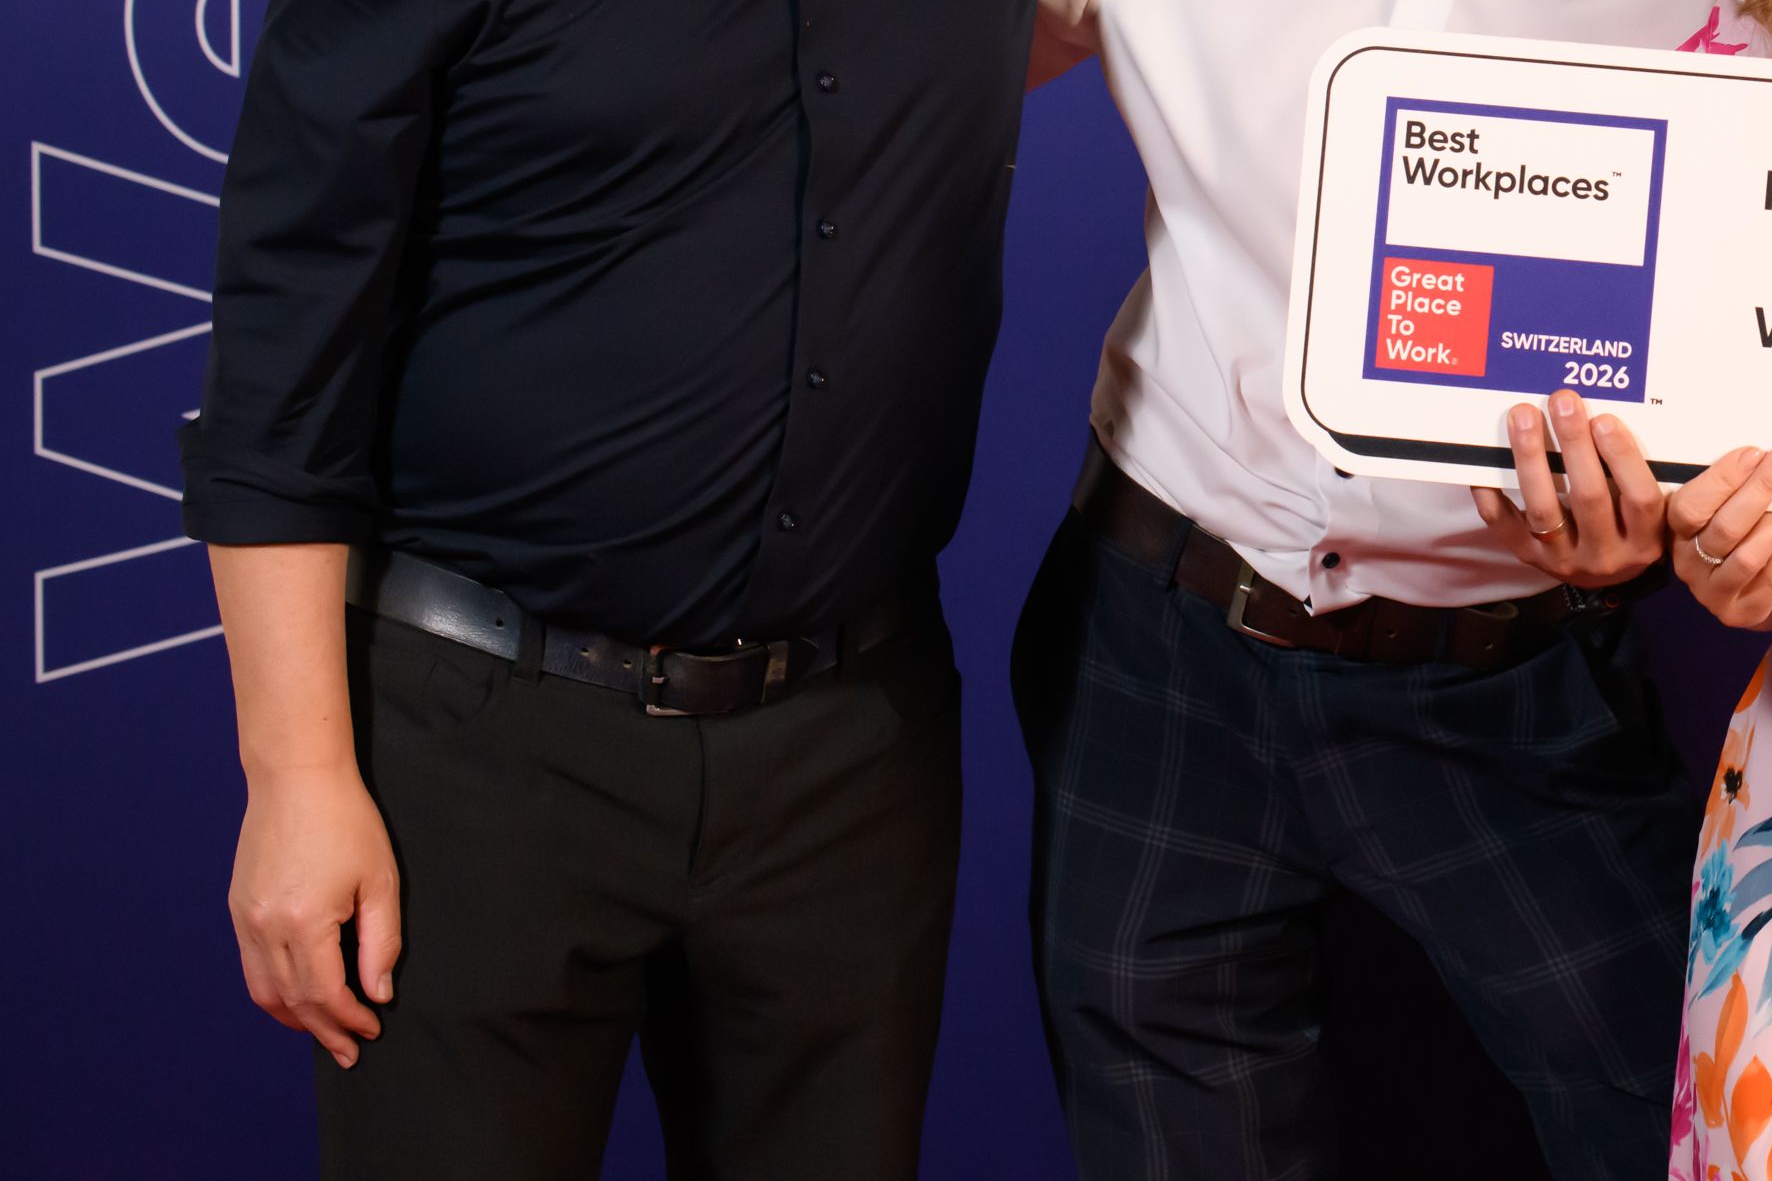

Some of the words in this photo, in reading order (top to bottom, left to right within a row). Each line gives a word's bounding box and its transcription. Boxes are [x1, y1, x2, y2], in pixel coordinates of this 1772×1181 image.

[1404, 120, 1480, 154] Best
[1390, 266, 1465, 292] Great
[1390, 290, 1461, 316] Place
[1387, 314, 1415, 336] To
[1501, 331, 1632, 358] SWITZERLAND
[1563, 361, 1630, 389] 2026
